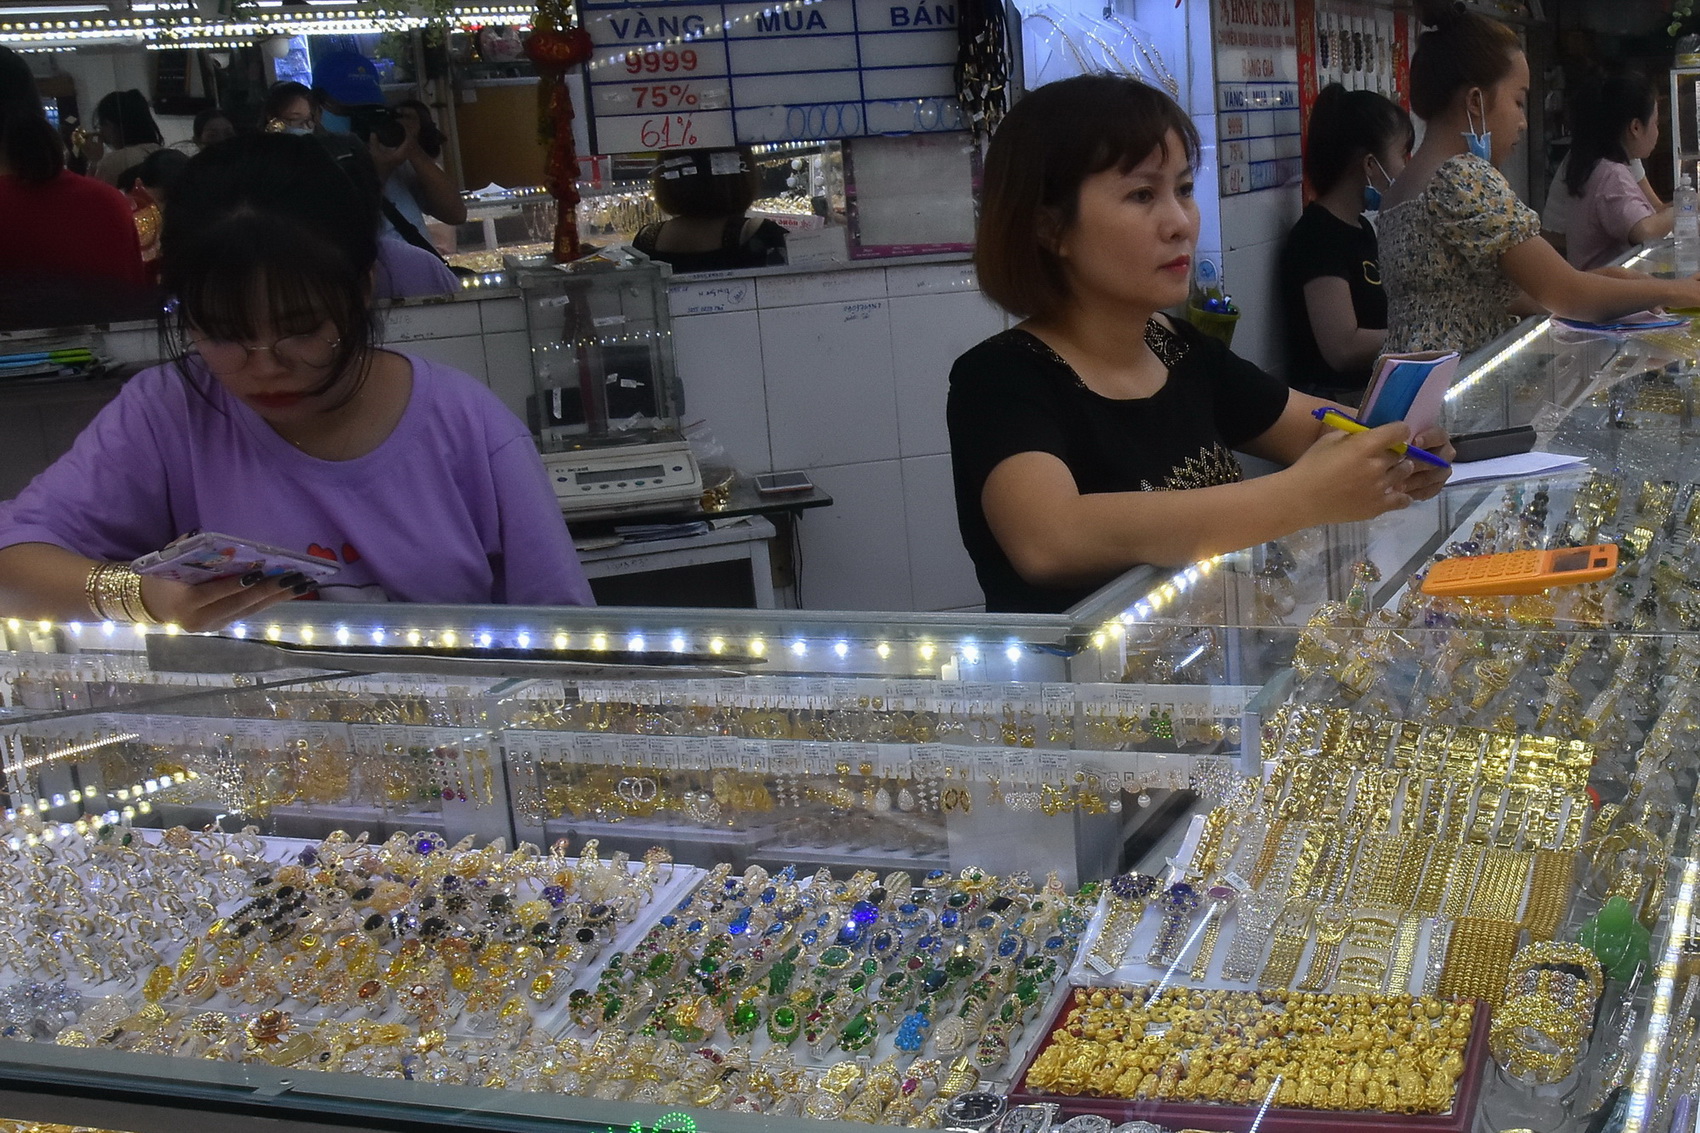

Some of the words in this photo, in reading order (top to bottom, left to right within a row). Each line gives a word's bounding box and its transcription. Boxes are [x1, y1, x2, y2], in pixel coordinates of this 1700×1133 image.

[609, 11, 705, 40] VÀNG
[757, 8, 827, 33] MUA
[890, 1, 955, 28] BÁN
[625, 49, 698, 74] 9999
[631, 84, 698, 109] 75%
[641, 114, 697, 149] 61%
